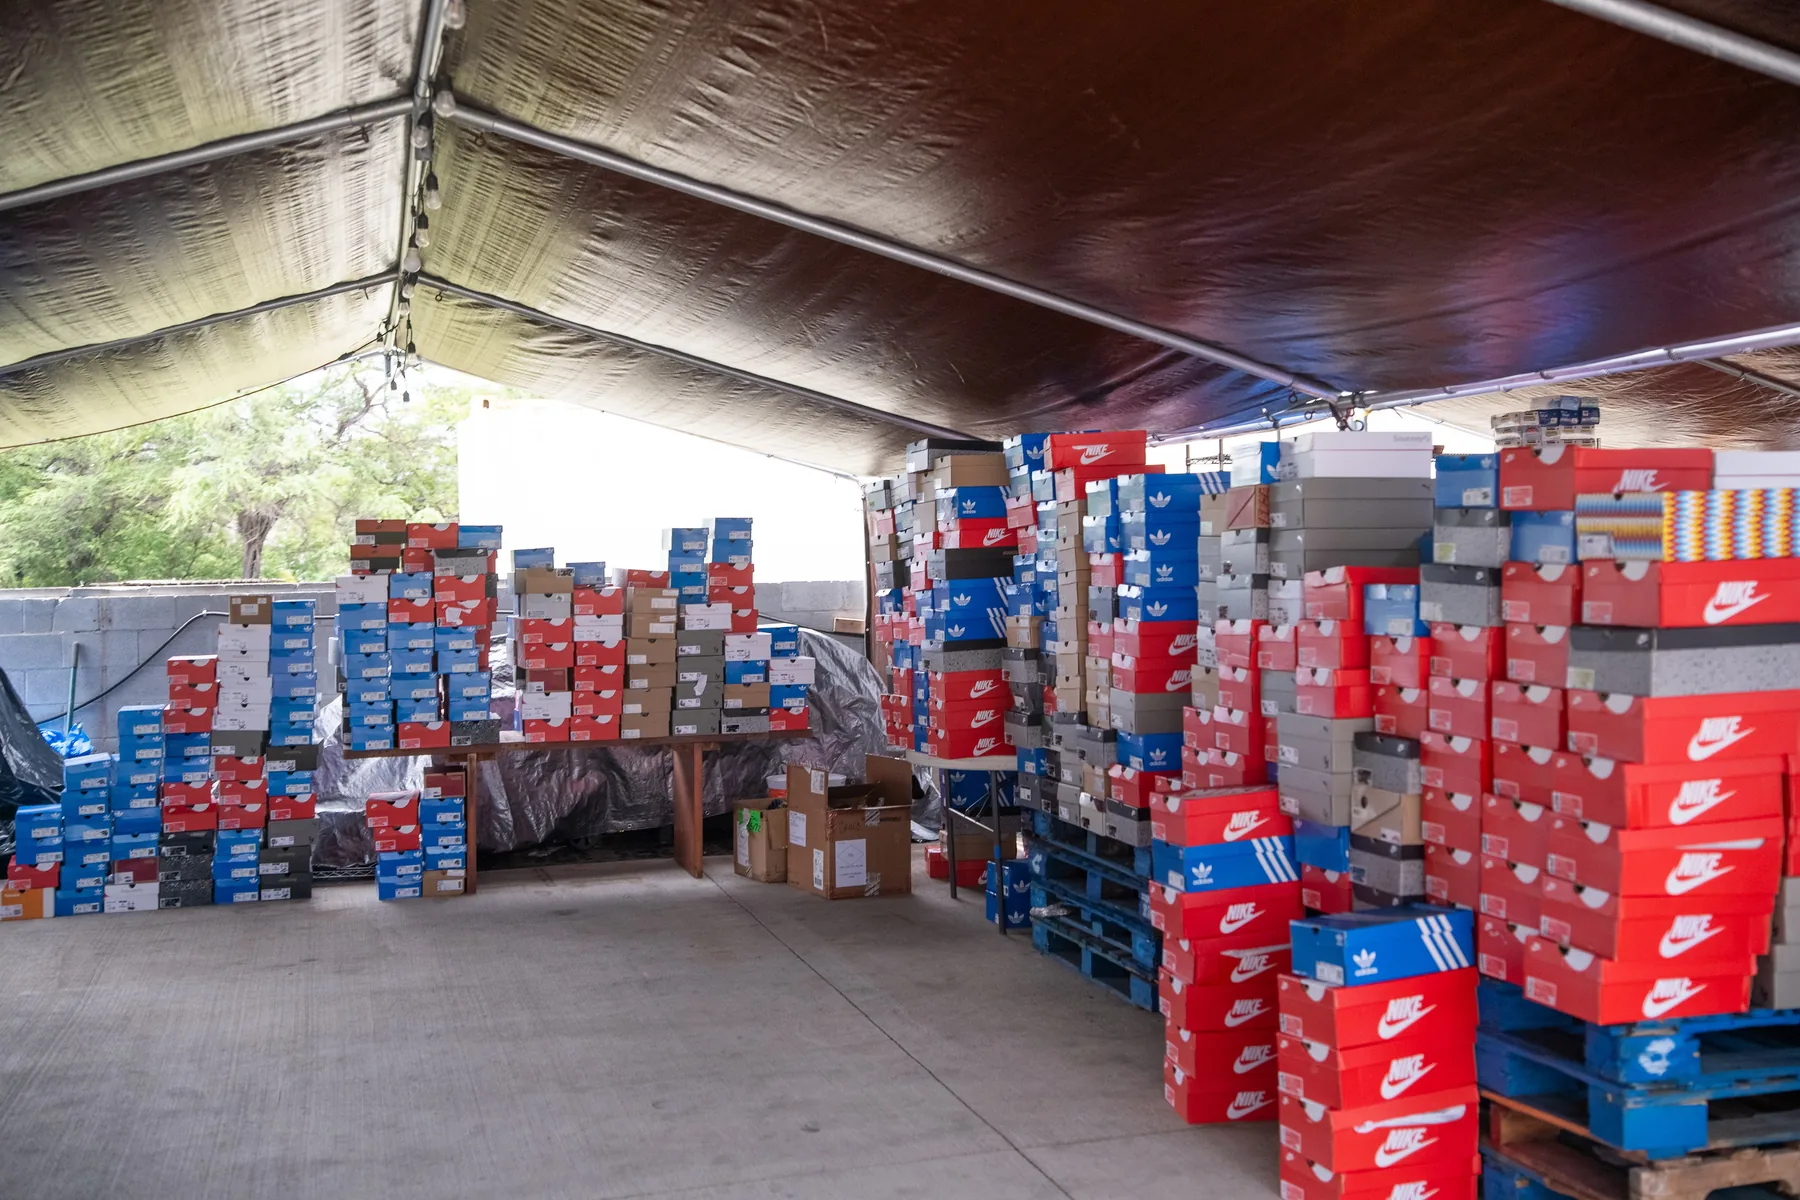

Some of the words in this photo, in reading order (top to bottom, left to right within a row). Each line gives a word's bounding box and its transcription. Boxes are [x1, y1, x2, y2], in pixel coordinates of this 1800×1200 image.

[1085, 444, 1108, 457] NIKE
[1620, 469, 1658, 491] NIKE
[987, 528, 1006, 539] NIKE
[1714, 581, 1758, 605] NIKE
[975, 680, 994, 691] NIKE
[975, 710, 994, 721] NIKE
[1698, 715, 1742, 741] NIKE
[977, 737, 996, 749] NIKE
[1678, 778, 1722, 805] NIKE
[1230, 810, 1260, 829] NIKE
[1676, 852, 1723, 876] NIKE
[1226, 902, 1256, 921] NIKE
[1669, 913, 1713, 939] NIKE
[1239, 955, 1269, 972] NIKE
[1652, 977, 1692, 999] NIKE
[1231, 999, 1263, 1015] NIKE
[1386, 994, 1424, 1022] NIKE
[1241, 1044, 1271, 1061] NIKE
[1388, 1053, 1424, 1081] NIKE
[1234, 1091, 1265, 1107] NIKE
[1384, 1127, 1427, 1151] NIKE
[1391, 1180, 1427, 1200] NIKE
